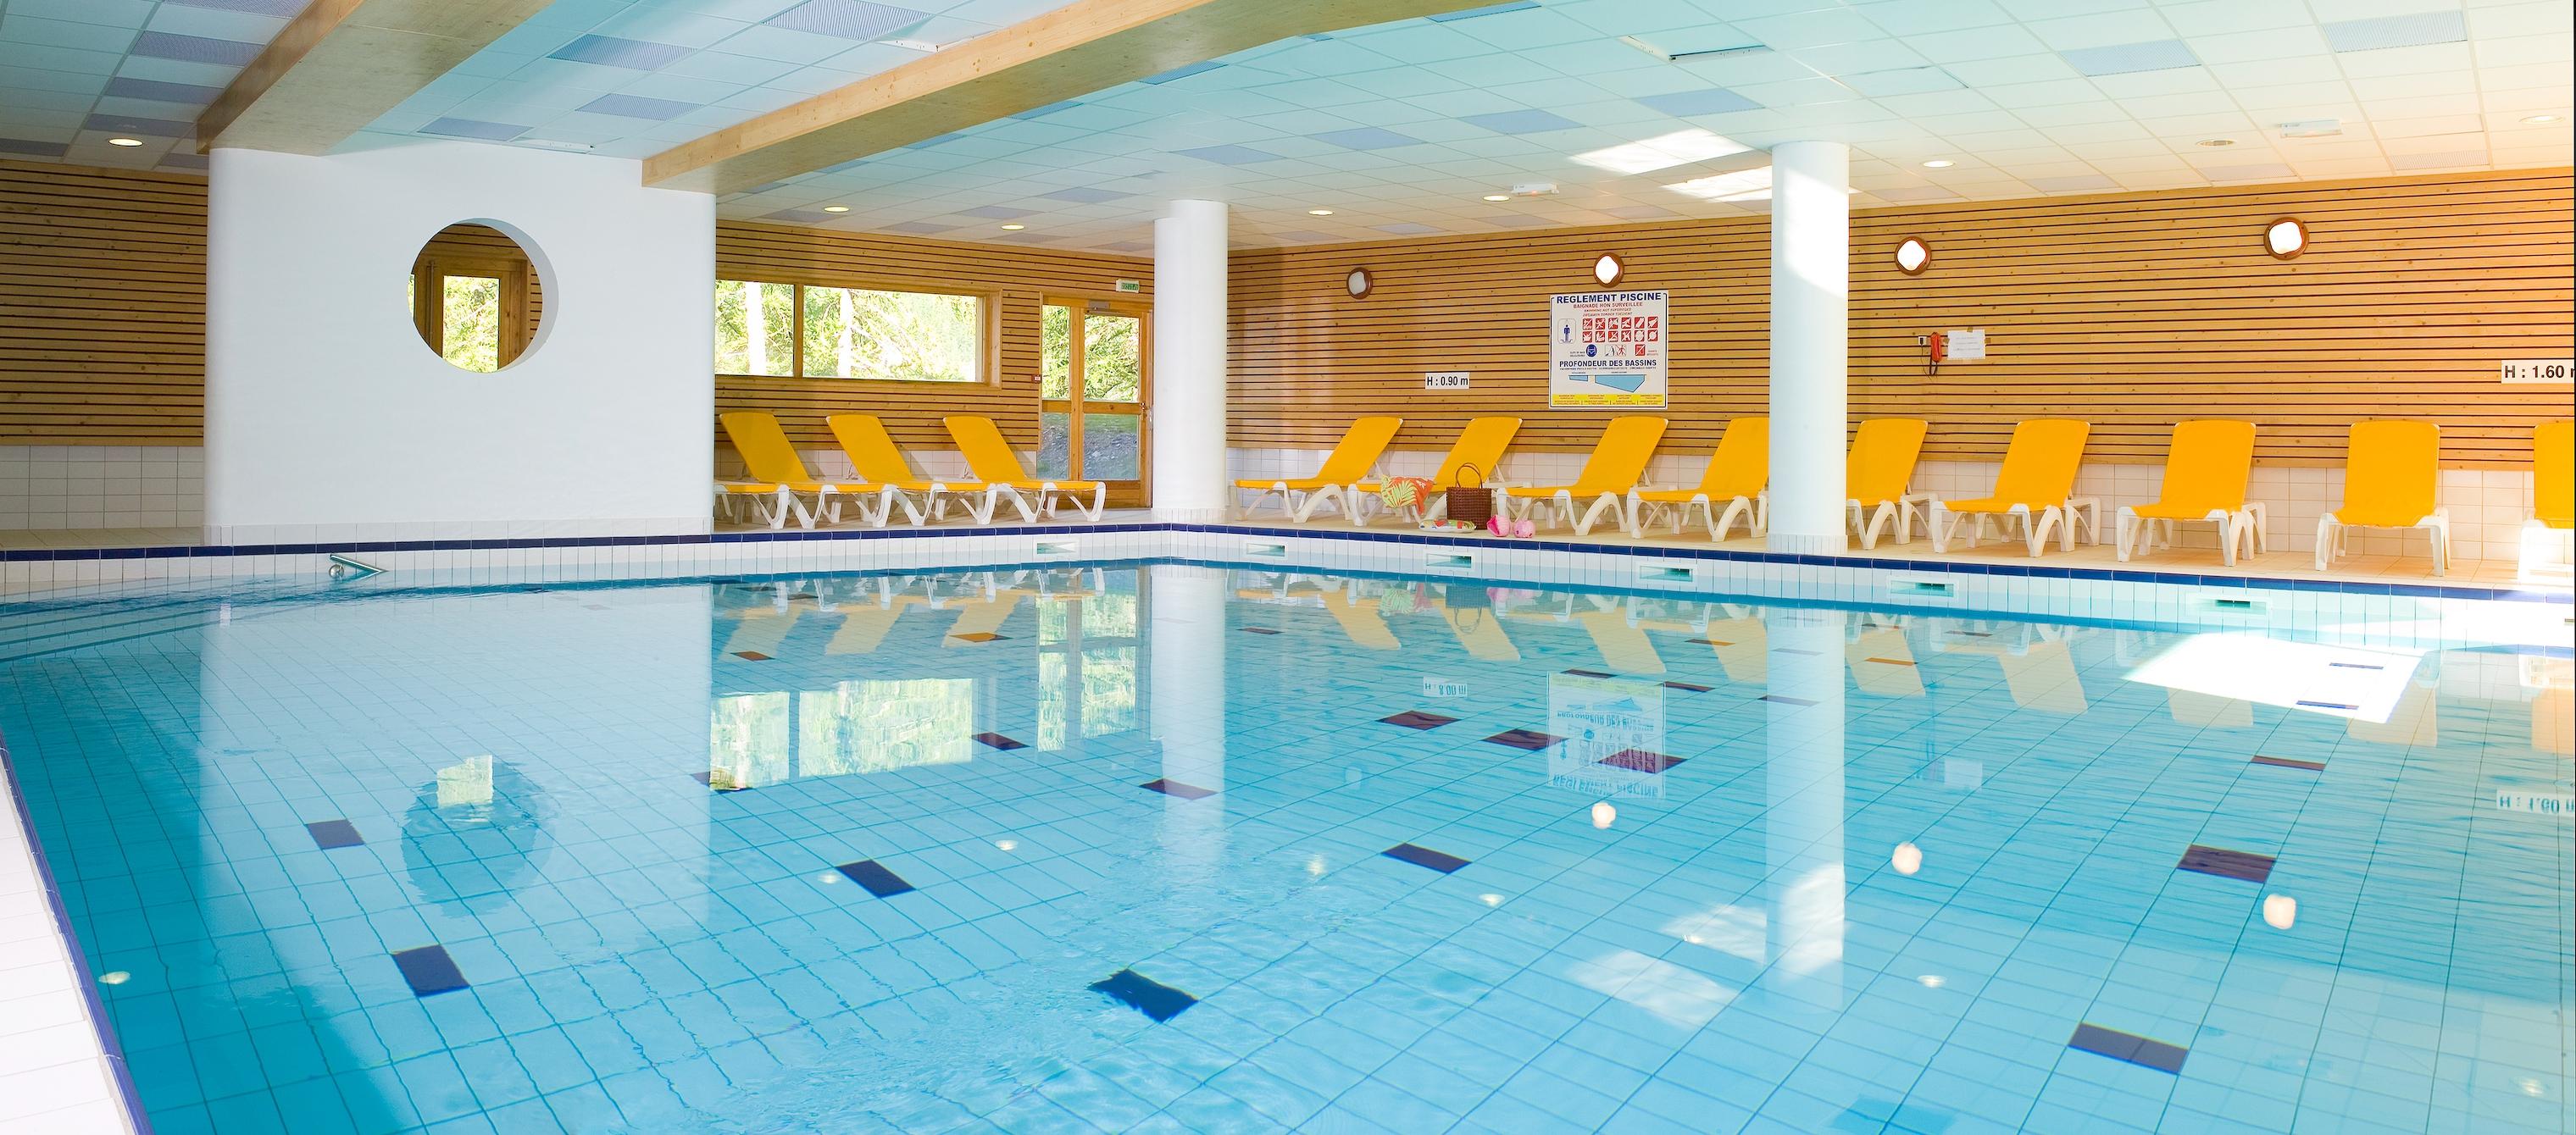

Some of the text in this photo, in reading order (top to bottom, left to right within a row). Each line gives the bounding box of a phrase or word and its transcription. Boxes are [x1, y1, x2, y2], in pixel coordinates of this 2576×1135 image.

[1557, 292, 1662, 303] REGLEMENT PISCINE
[2505, 365, 2515, 378] H
[2532, 365, 2565, 378] 1.60
[1427, 376, 1433, 385] H
[1441, 376, 1457, 385] 0.90
